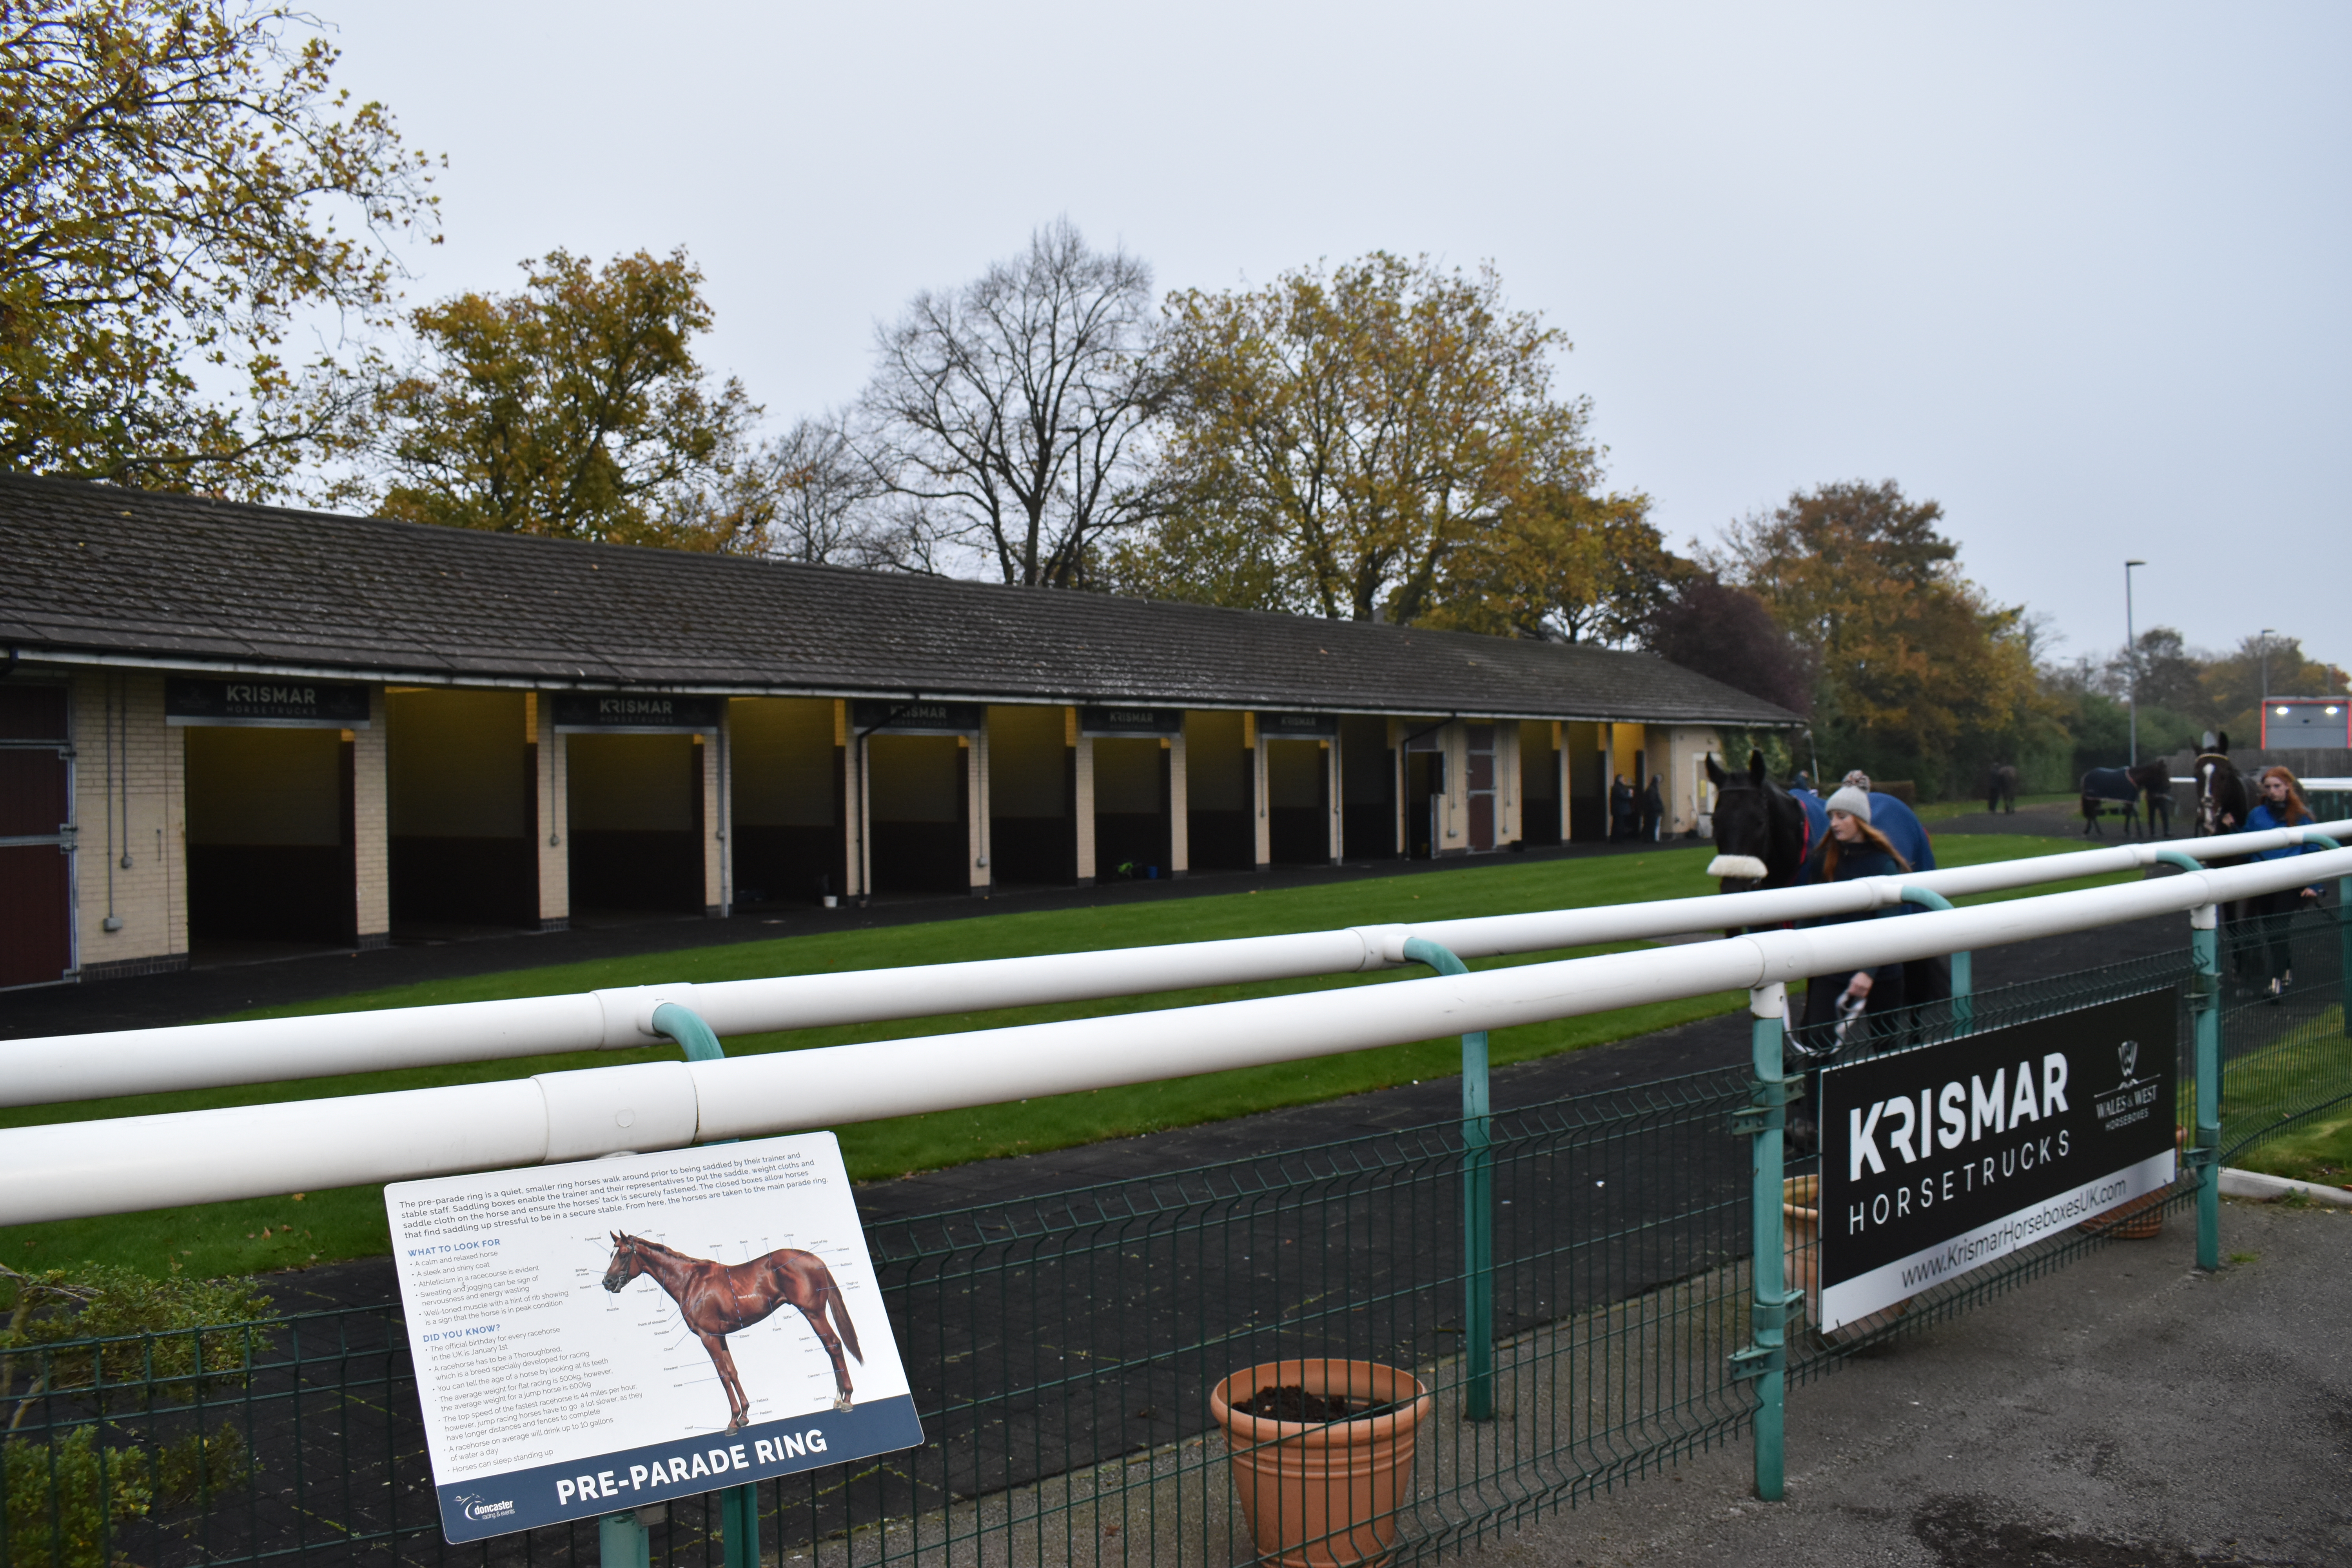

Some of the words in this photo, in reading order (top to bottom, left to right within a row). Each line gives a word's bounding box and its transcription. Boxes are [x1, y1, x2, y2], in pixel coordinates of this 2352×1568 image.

[227, 685, 315, 704] KRISMAR
[227, 706, 317, 715] HORSETRUCKS
[599, 699, 672, 714] KRISMAR
[2096, 1095, 2126, 1119] WALES
[2134, 1084, 2158, 1105] WEST
[1850, 1052, 2069, 1181] KRISMAR
[401, 1209, 428, 1218] stable
[429, 1205, 451, 1215] staff.
[452, 1202, 490, 1212] Saddling
[491, 1199, 515, 1207] boxes
[517, 1194, 545, 1204] enable
[562, 1190, 588, 1198] trainer
[590, 1186, 605, 1195] and
[606, 1184, 624, 1192] their
[626, 1177, 685, 1190] representatives
[695, 1173, 709, 1182] put
[724, 1168, 751, 1177] saddle,
[751, 1164, 777, 1173] weight
[777, 1161, 800, 1170] cloths
[801, 1159, 815, 1167] and
[417, 1194, 465, 1208] pre-parade
[500, 1187, 524, 1197] quiet,
[525, 1184, 555, 1193] smaller
[574, 1179, 601, 1187] horses
[601, 1175, 621, 1183] walk
[622, 1171, 650, 1181] around
[650, 1169, 668, 1178] prior
[679, 1165, 701, 1174] being
[702, 1160, 733, 1171] saddled
[744, 1157, 760, 1165] their
[762, 1154, 785, 1163] trainer
[787, 1151, 801, 1160] and
[1850, 1129, 2069, 1235] HORSETRUCKS
[403, 1219, 432, 1229] saddle
[434, 1215, 456, 1225] cloth
[485, 1210, 509, 1218] horse
[511, 1206, 526, 1215] and
[528, 1204, 556, 1212] ensure
[602, 1194, 620, 1203] tack
[629, 1189, 661, 1200] securely
[662, 1184, 698, 1195] fastened.
[715, 1178, 740, 1188] closed
[740, 1176, 763, 1185] boxes
[784, 1170, 809, 1178] horses
[404, 1230, 422, 1239] that
[423, 1227, 441, 1236] find
[442, 1223, 479, 1234] saddling
[493, 1216, 530, 1227] stressful
[569, 1209, 596, 1218] secure
[597, 1204, 624, 1214] stable.
[681, 1194, 707, 1202] horses
[722, 1189, 743, 1197] taken
[767, 1182, 785, 1191] main
[786, 1178, 811, 1189] parade
[1902, 1180, 2127, 1288] www.KrismarHorseboxesUK.com
[407, 1246, 436, 1257] WHAT
[437, 1245, 451, 1253] TO
[453, 1241, 480, 1251] LOOK
[481, 1238, 501, 1247] FOR
[453, 1252, 478, 1261] relaxed
[418, 1277, 456, 1287] Athleticism
[470, 1270, 507, 1280] racecourse
[515, 1265, 539, 1274] evident
[423, 1268, 441, 1276] sleek
[442, 1265, 456, 1274] and
[423, 1305, 462, 1316] Well-toned
[463, 1302, 488, 1311] muscle
[541, 1290, 569, 1299] showing
[453, 1313, 467, 1321] that
[515, 1303, 532, 1313] peak
[532, 1300, 563, 1309] condition
[423, 1333, 440, 1342] DID
[441, 1329, 463, 1339] YOU
[465, 1323, 500, 1336] KNOW?
[445, 1340, 468, 1350] official
[468, 1337, 496, 1347] birthday
[527, 1327, 560, 1337] racehorse
[556, 1444, 749, 1505] PRE-PARADE
[755, 1429, 828, 1464] RING
[474, 1501, 513, 1515] doncaster
